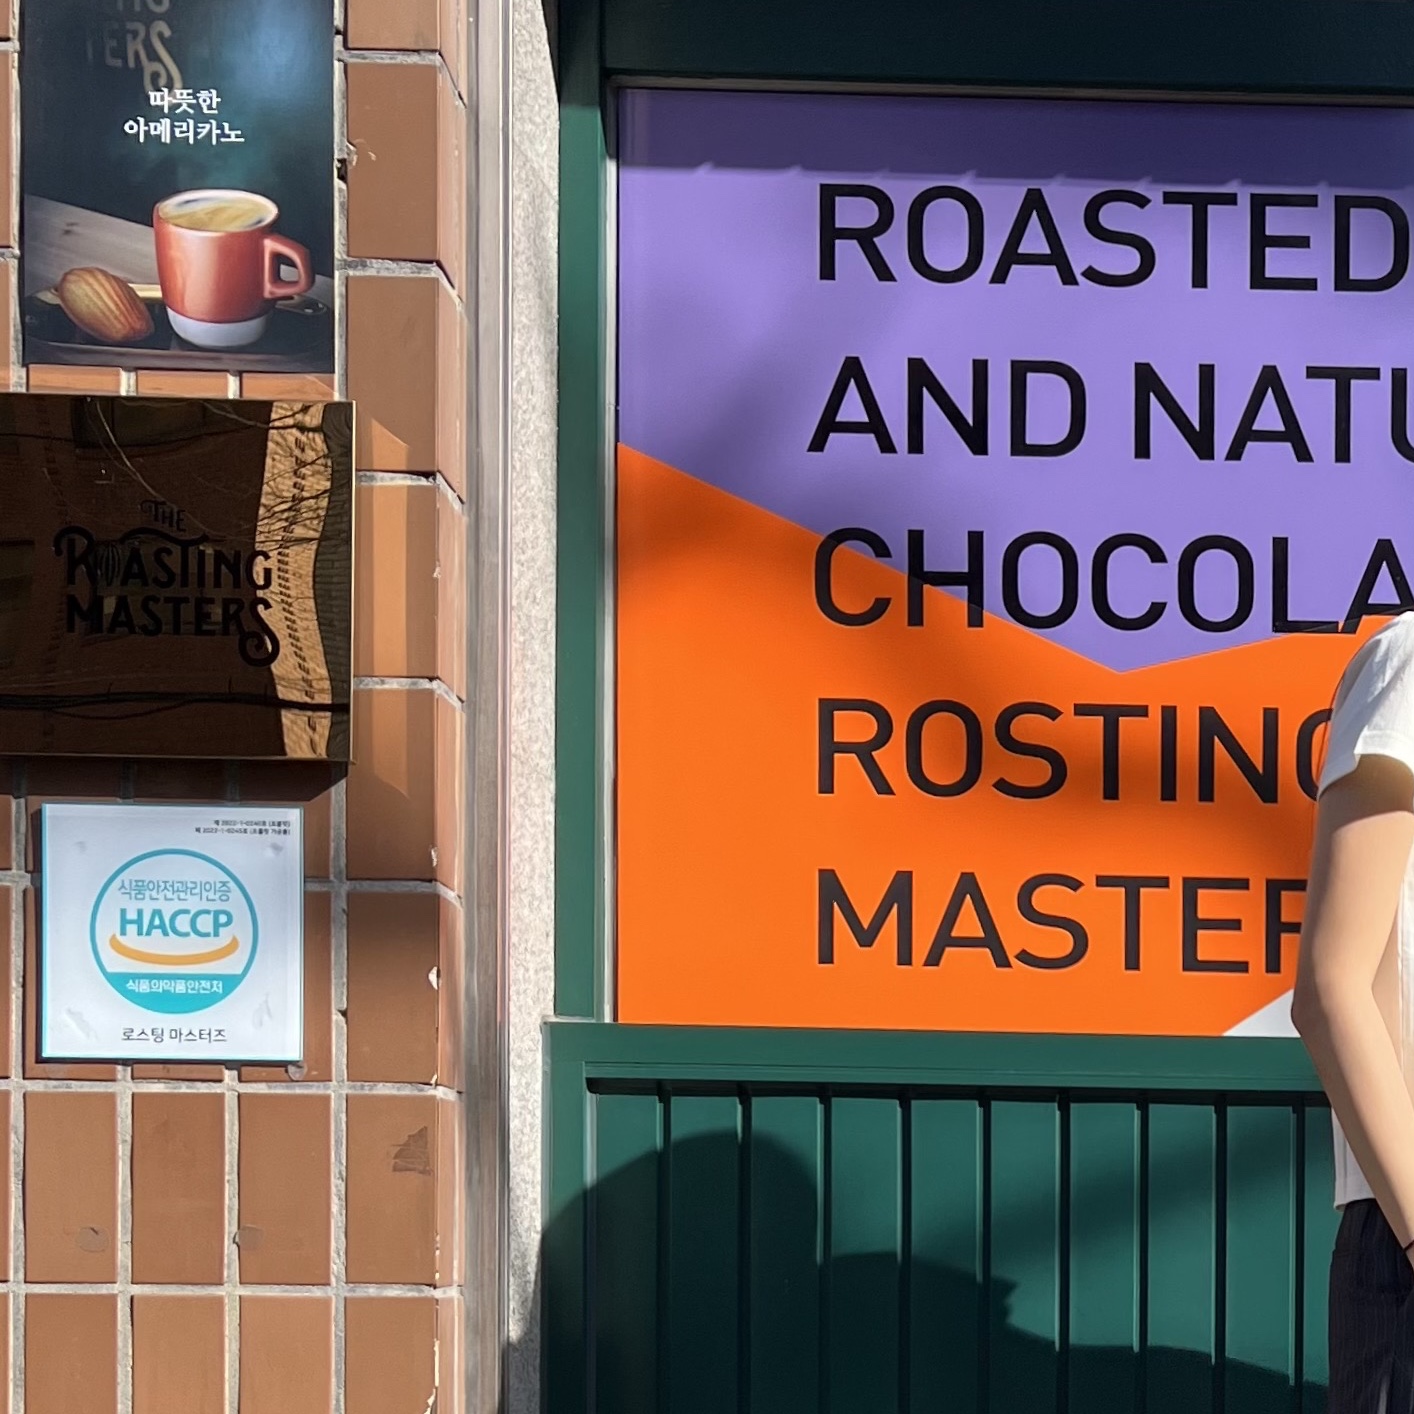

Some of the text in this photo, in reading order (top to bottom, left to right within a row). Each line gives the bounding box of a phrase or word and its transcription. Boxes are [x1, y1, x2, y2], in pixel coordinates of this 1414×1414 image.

[149, 87, 221, 114] 따뜻한
[123, 116, 245, 145] 아메리카노
[817, 183, 1408, 292] ROASTED
[807, 356, 1087, 457] AND
[140, 499, 187, 532] THE
[66, 594, 281, 668] MASTERS
[118, 879, 232, 903] 식품안전관리인증
[119, 907, 234, 938] HACCP
[126, 978, 224, 995] 식품의약품안전처
[121, 1027, 228, 1044] 로스팅 마스터즈
